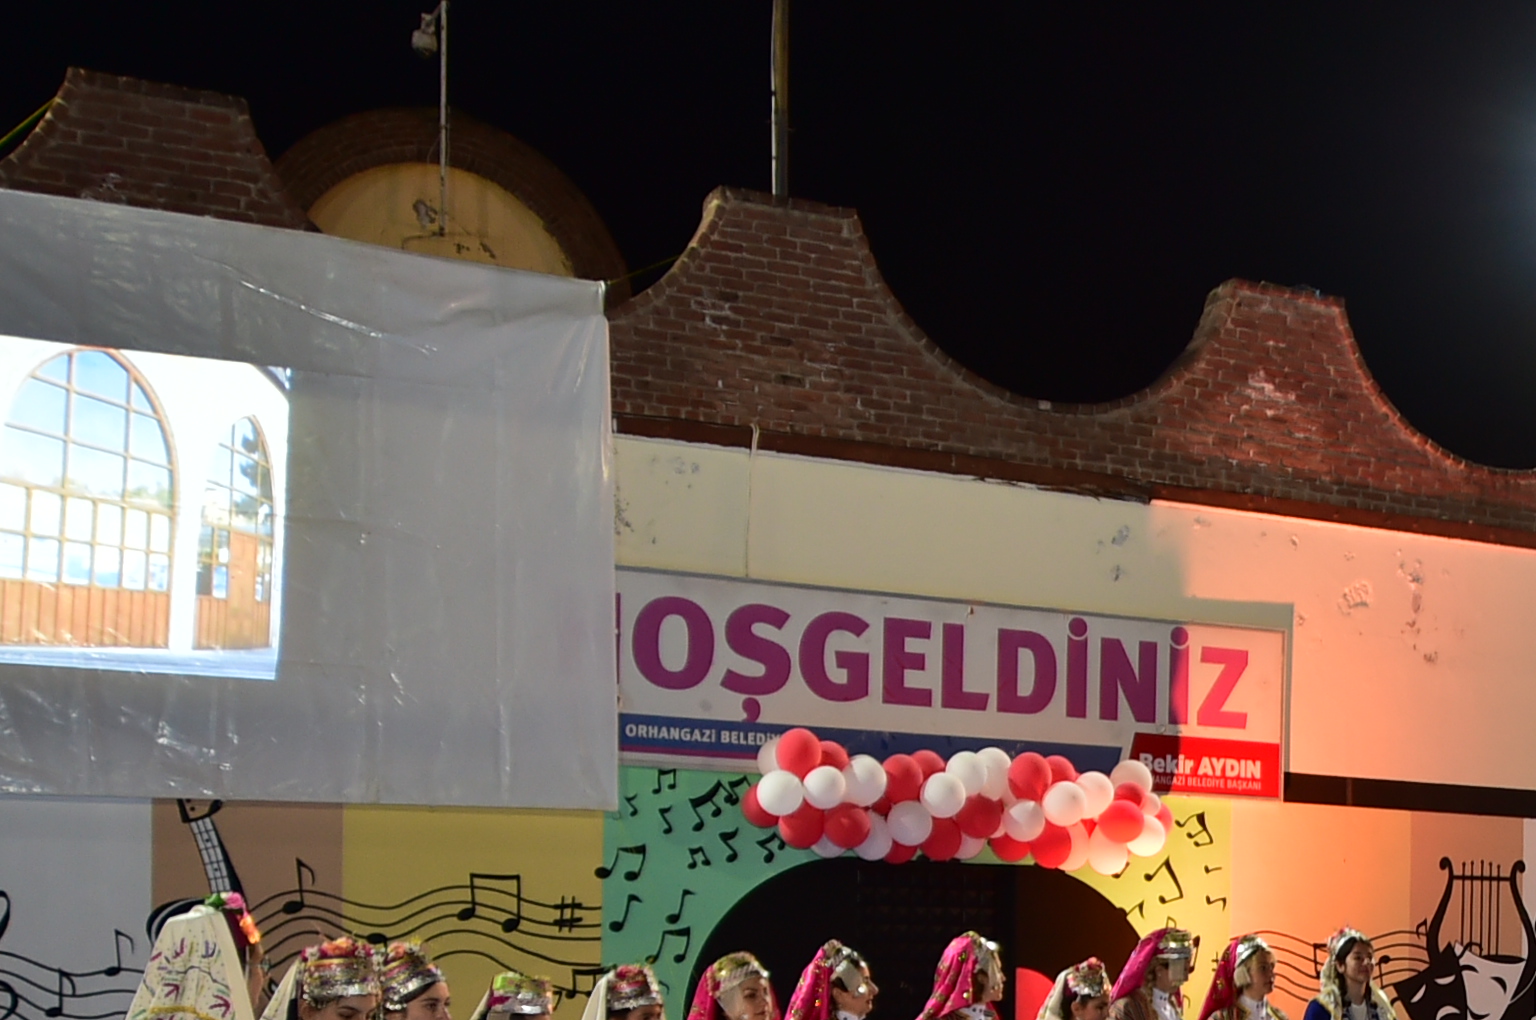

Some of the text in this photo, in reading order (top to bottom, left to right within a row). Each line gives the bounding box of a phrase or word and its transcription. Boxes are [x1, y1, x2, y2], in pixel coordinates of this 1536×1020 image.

[615, 592, 1249, 730] OŞGELDİNİZ
[625, 724, 716, 743] ORHANGAZİ
[1139, 752, 1261, 779] Bekir AYDIN
